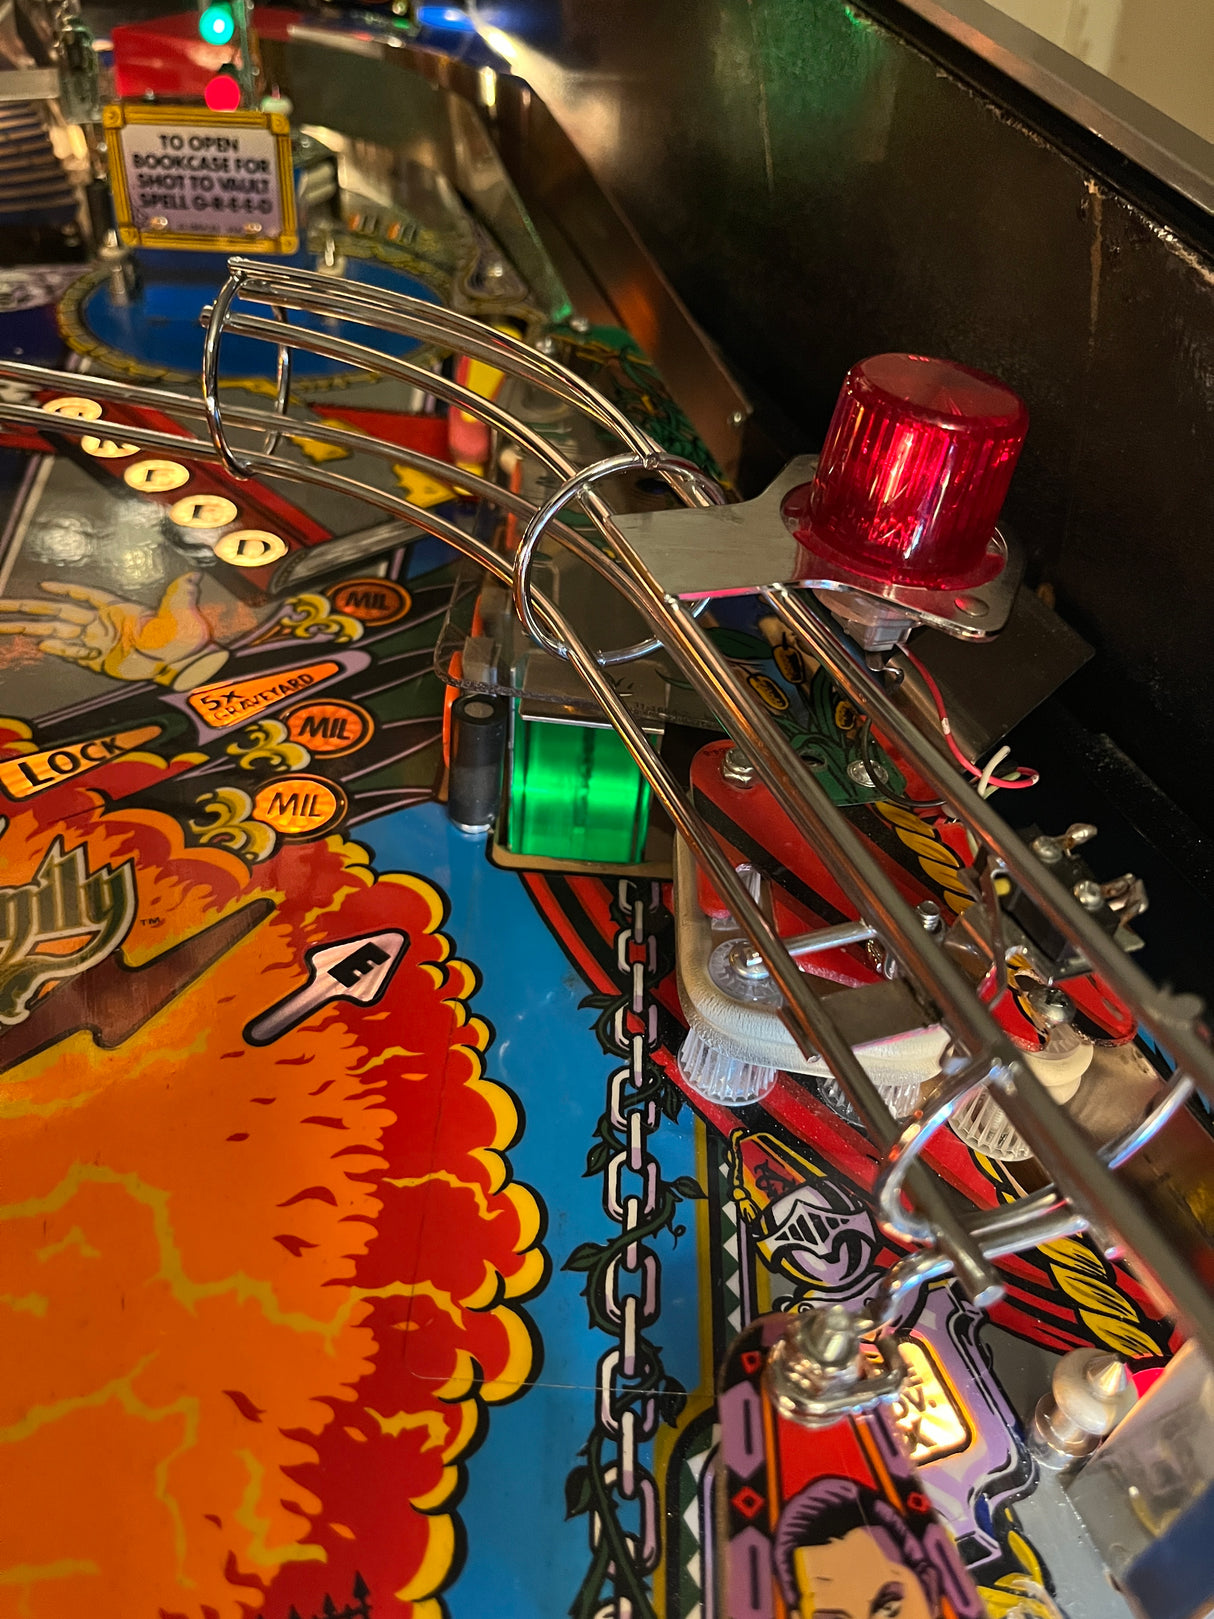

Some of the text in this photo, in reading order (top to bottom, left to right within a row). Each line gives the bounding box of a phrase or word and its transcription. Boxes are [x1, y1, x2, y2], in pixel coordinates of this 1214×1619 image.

[158, 133, 239, 153] TO OPEN
[132, 153, 270, 175] BOOKCASE FOR
[137, 172, 270, 196] SHOT TO VAULT
[139, 193, 189, 211] SPELL
[345, 591, 391, 610] MIL
[200, 691, 243, 711] 5X
[213, 673, 315, 720] GRAVEYARD
[298, 715, 350, 740] MIL
[17, 736, 128, 787] LOCK
[266, 791, 322, 817] MIL
[140, 916, 161, 927] TM
